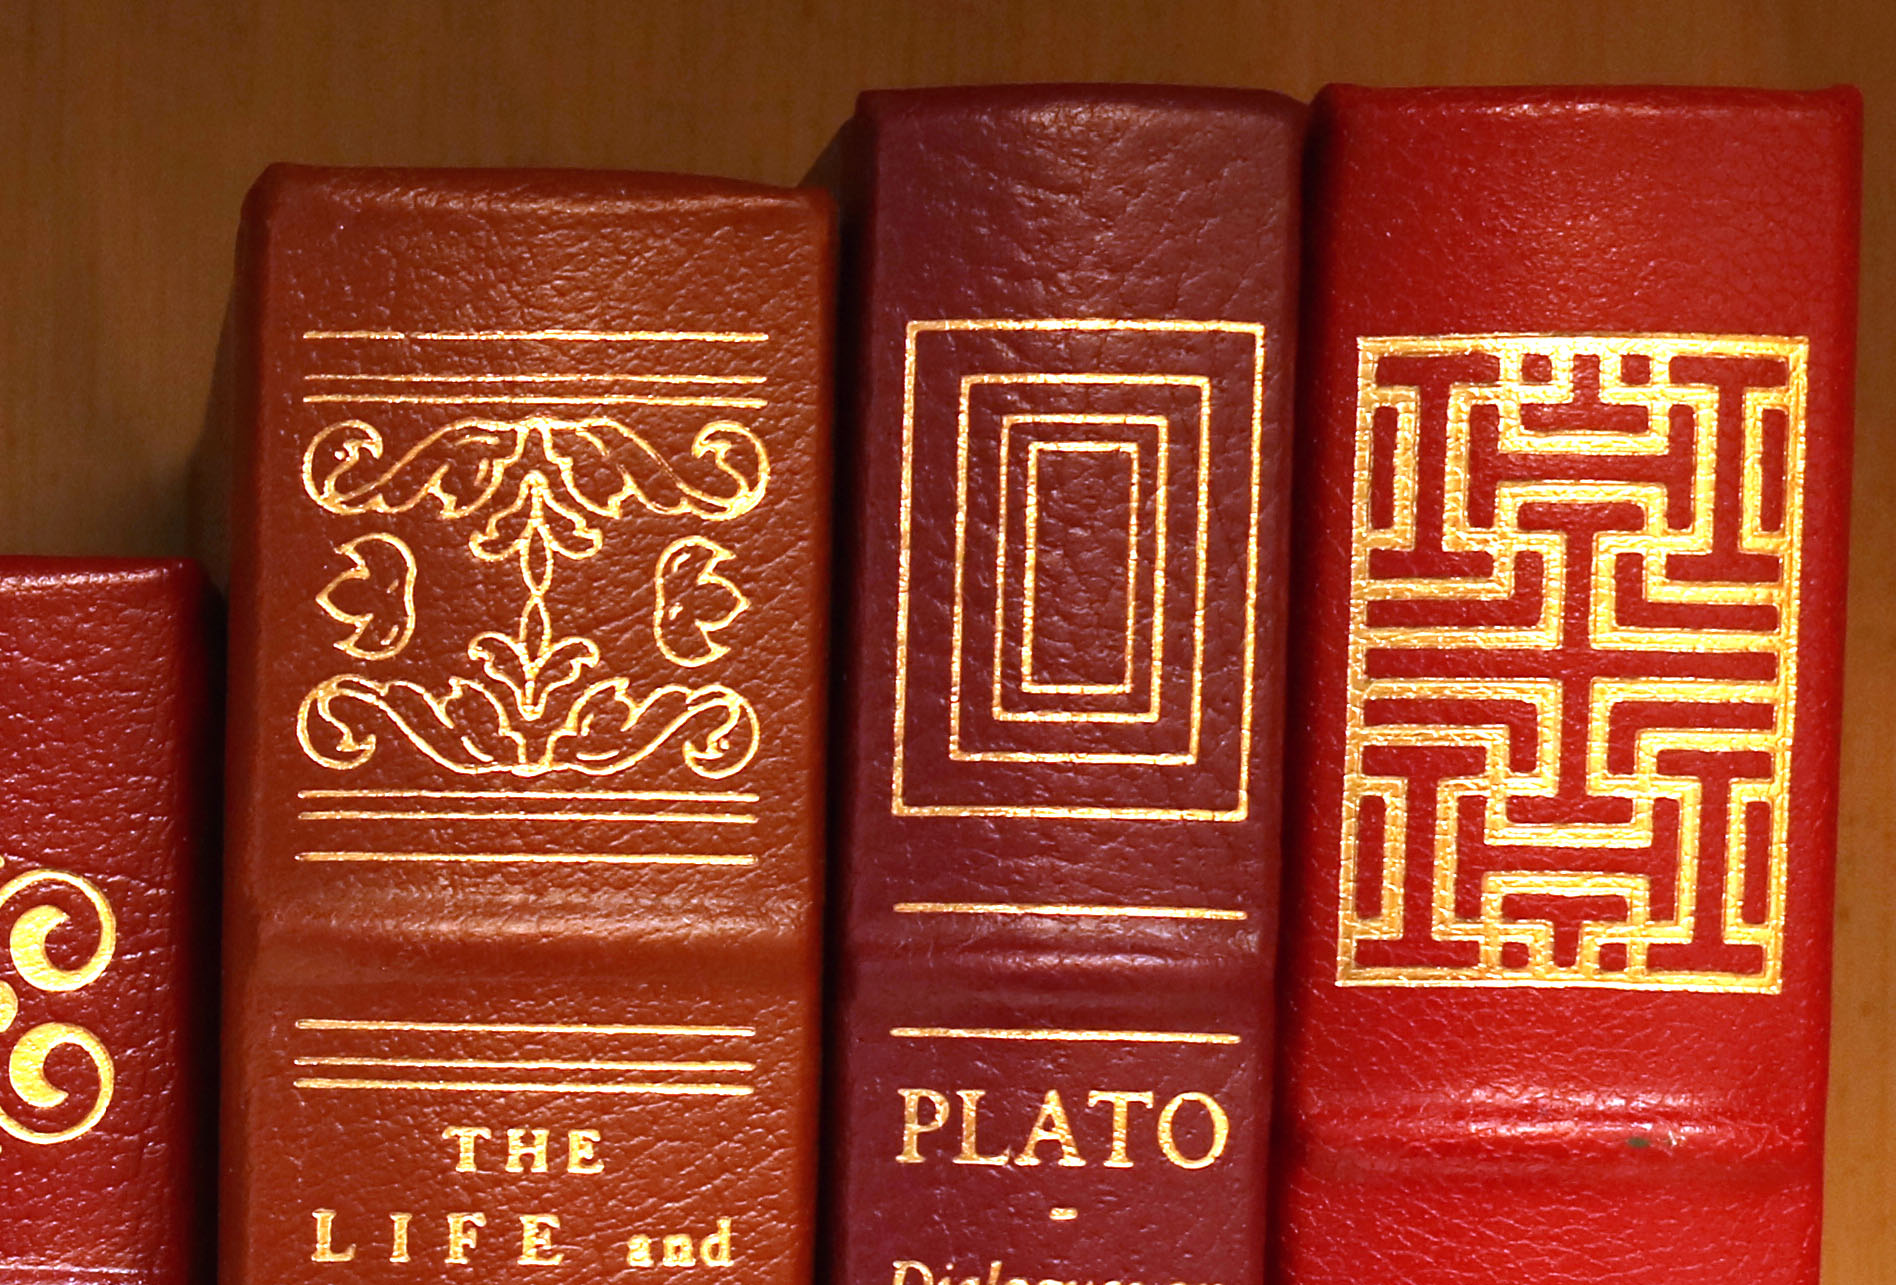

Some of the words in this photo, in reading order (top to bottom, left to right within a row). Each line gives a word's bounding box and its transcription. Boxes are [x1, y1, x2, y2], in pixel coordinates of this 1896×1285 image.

[442, 1126, 607, 1174] THE
[894, 1088, 1230, 1170] PLATO
[310, 1209, 567, 1266] LIFE
[625, 1218, 736, 1268] and
